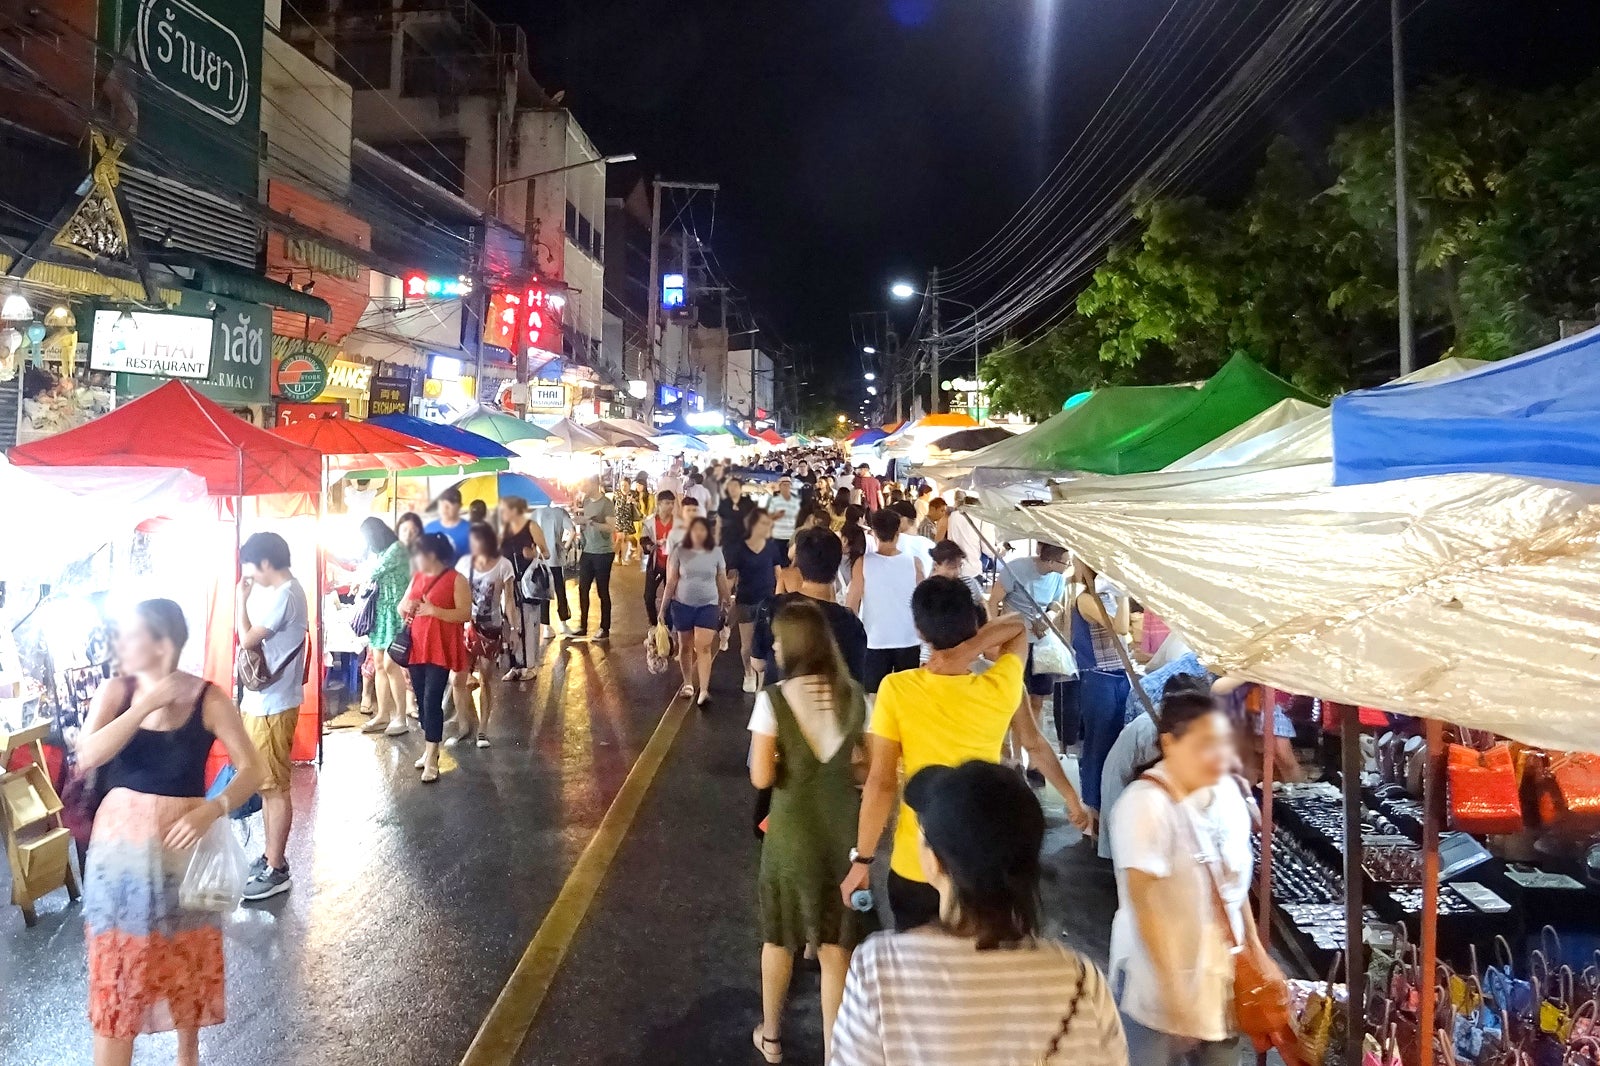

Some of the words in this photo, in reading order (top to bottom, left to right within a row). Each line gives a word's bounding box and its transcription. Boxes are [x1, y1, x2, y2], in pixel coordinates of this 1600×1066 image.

[157, 8, 234, 101] ร้านยา
[141, 339, 194, 359] THAI
[125, 356, 206, 374] RESTAURANT
[326, 364, 372, 390] HANGE
[537, 390, 558, 399] THAI
